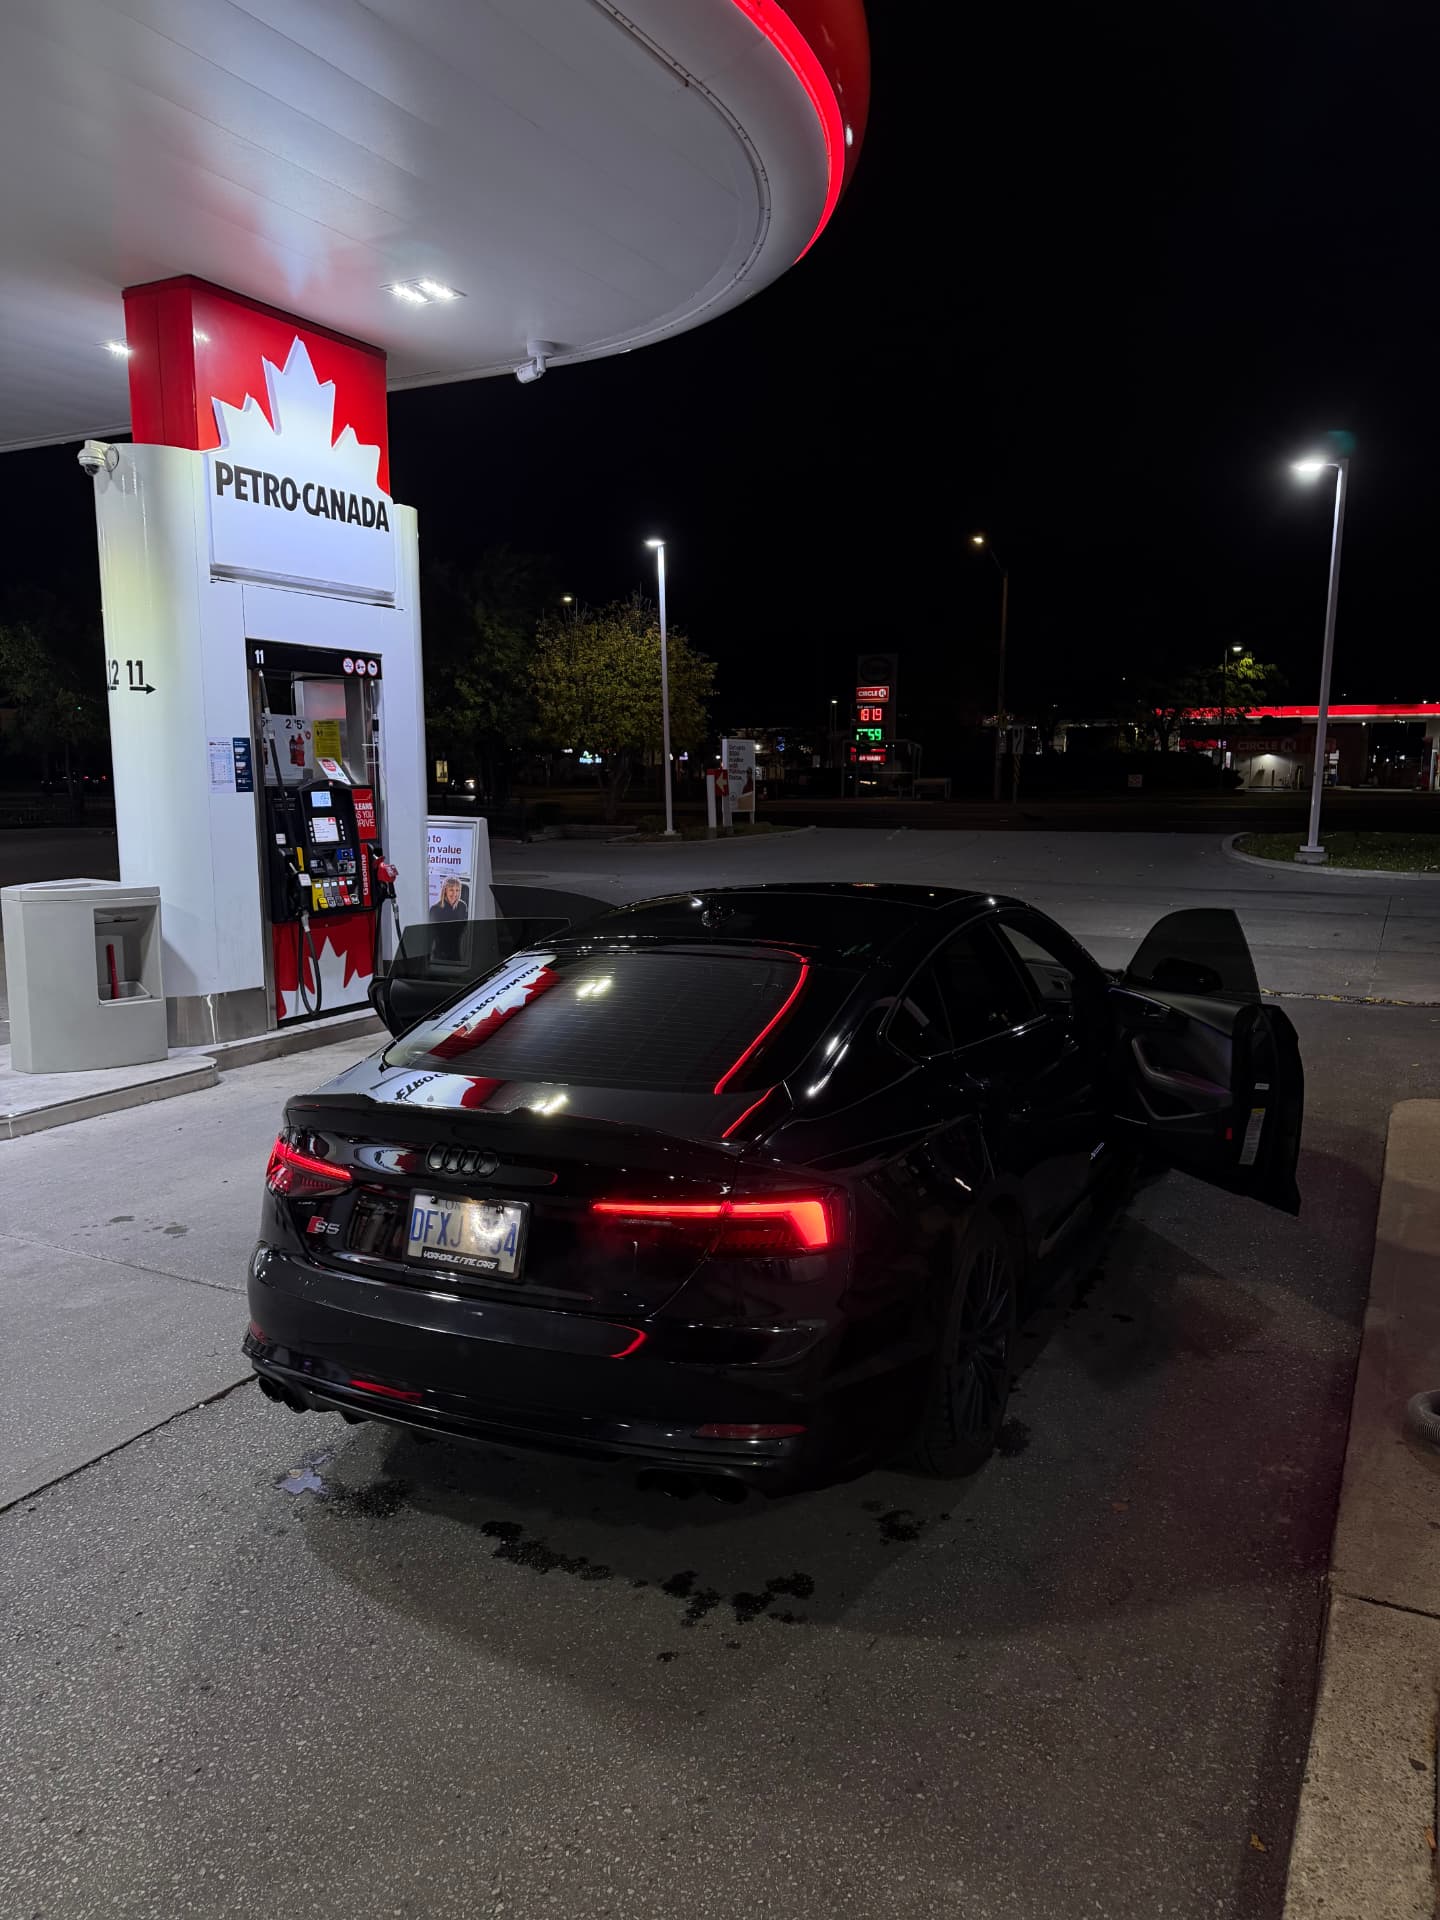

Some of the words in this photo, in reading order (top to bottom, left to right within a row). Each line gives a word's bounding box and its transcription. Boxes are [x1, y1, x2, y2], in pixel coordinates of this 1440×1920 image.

[255, 649, 264, 665] 11
[126, 660, 143, 685] 11
[432, 835, 441, 843] to
[437, 845, 462, 854] value
[427, 854, 461, 865] latinum
[315, 1220, 340, 1235] S5
[410, 1207, 463, 1248] DFXJ
